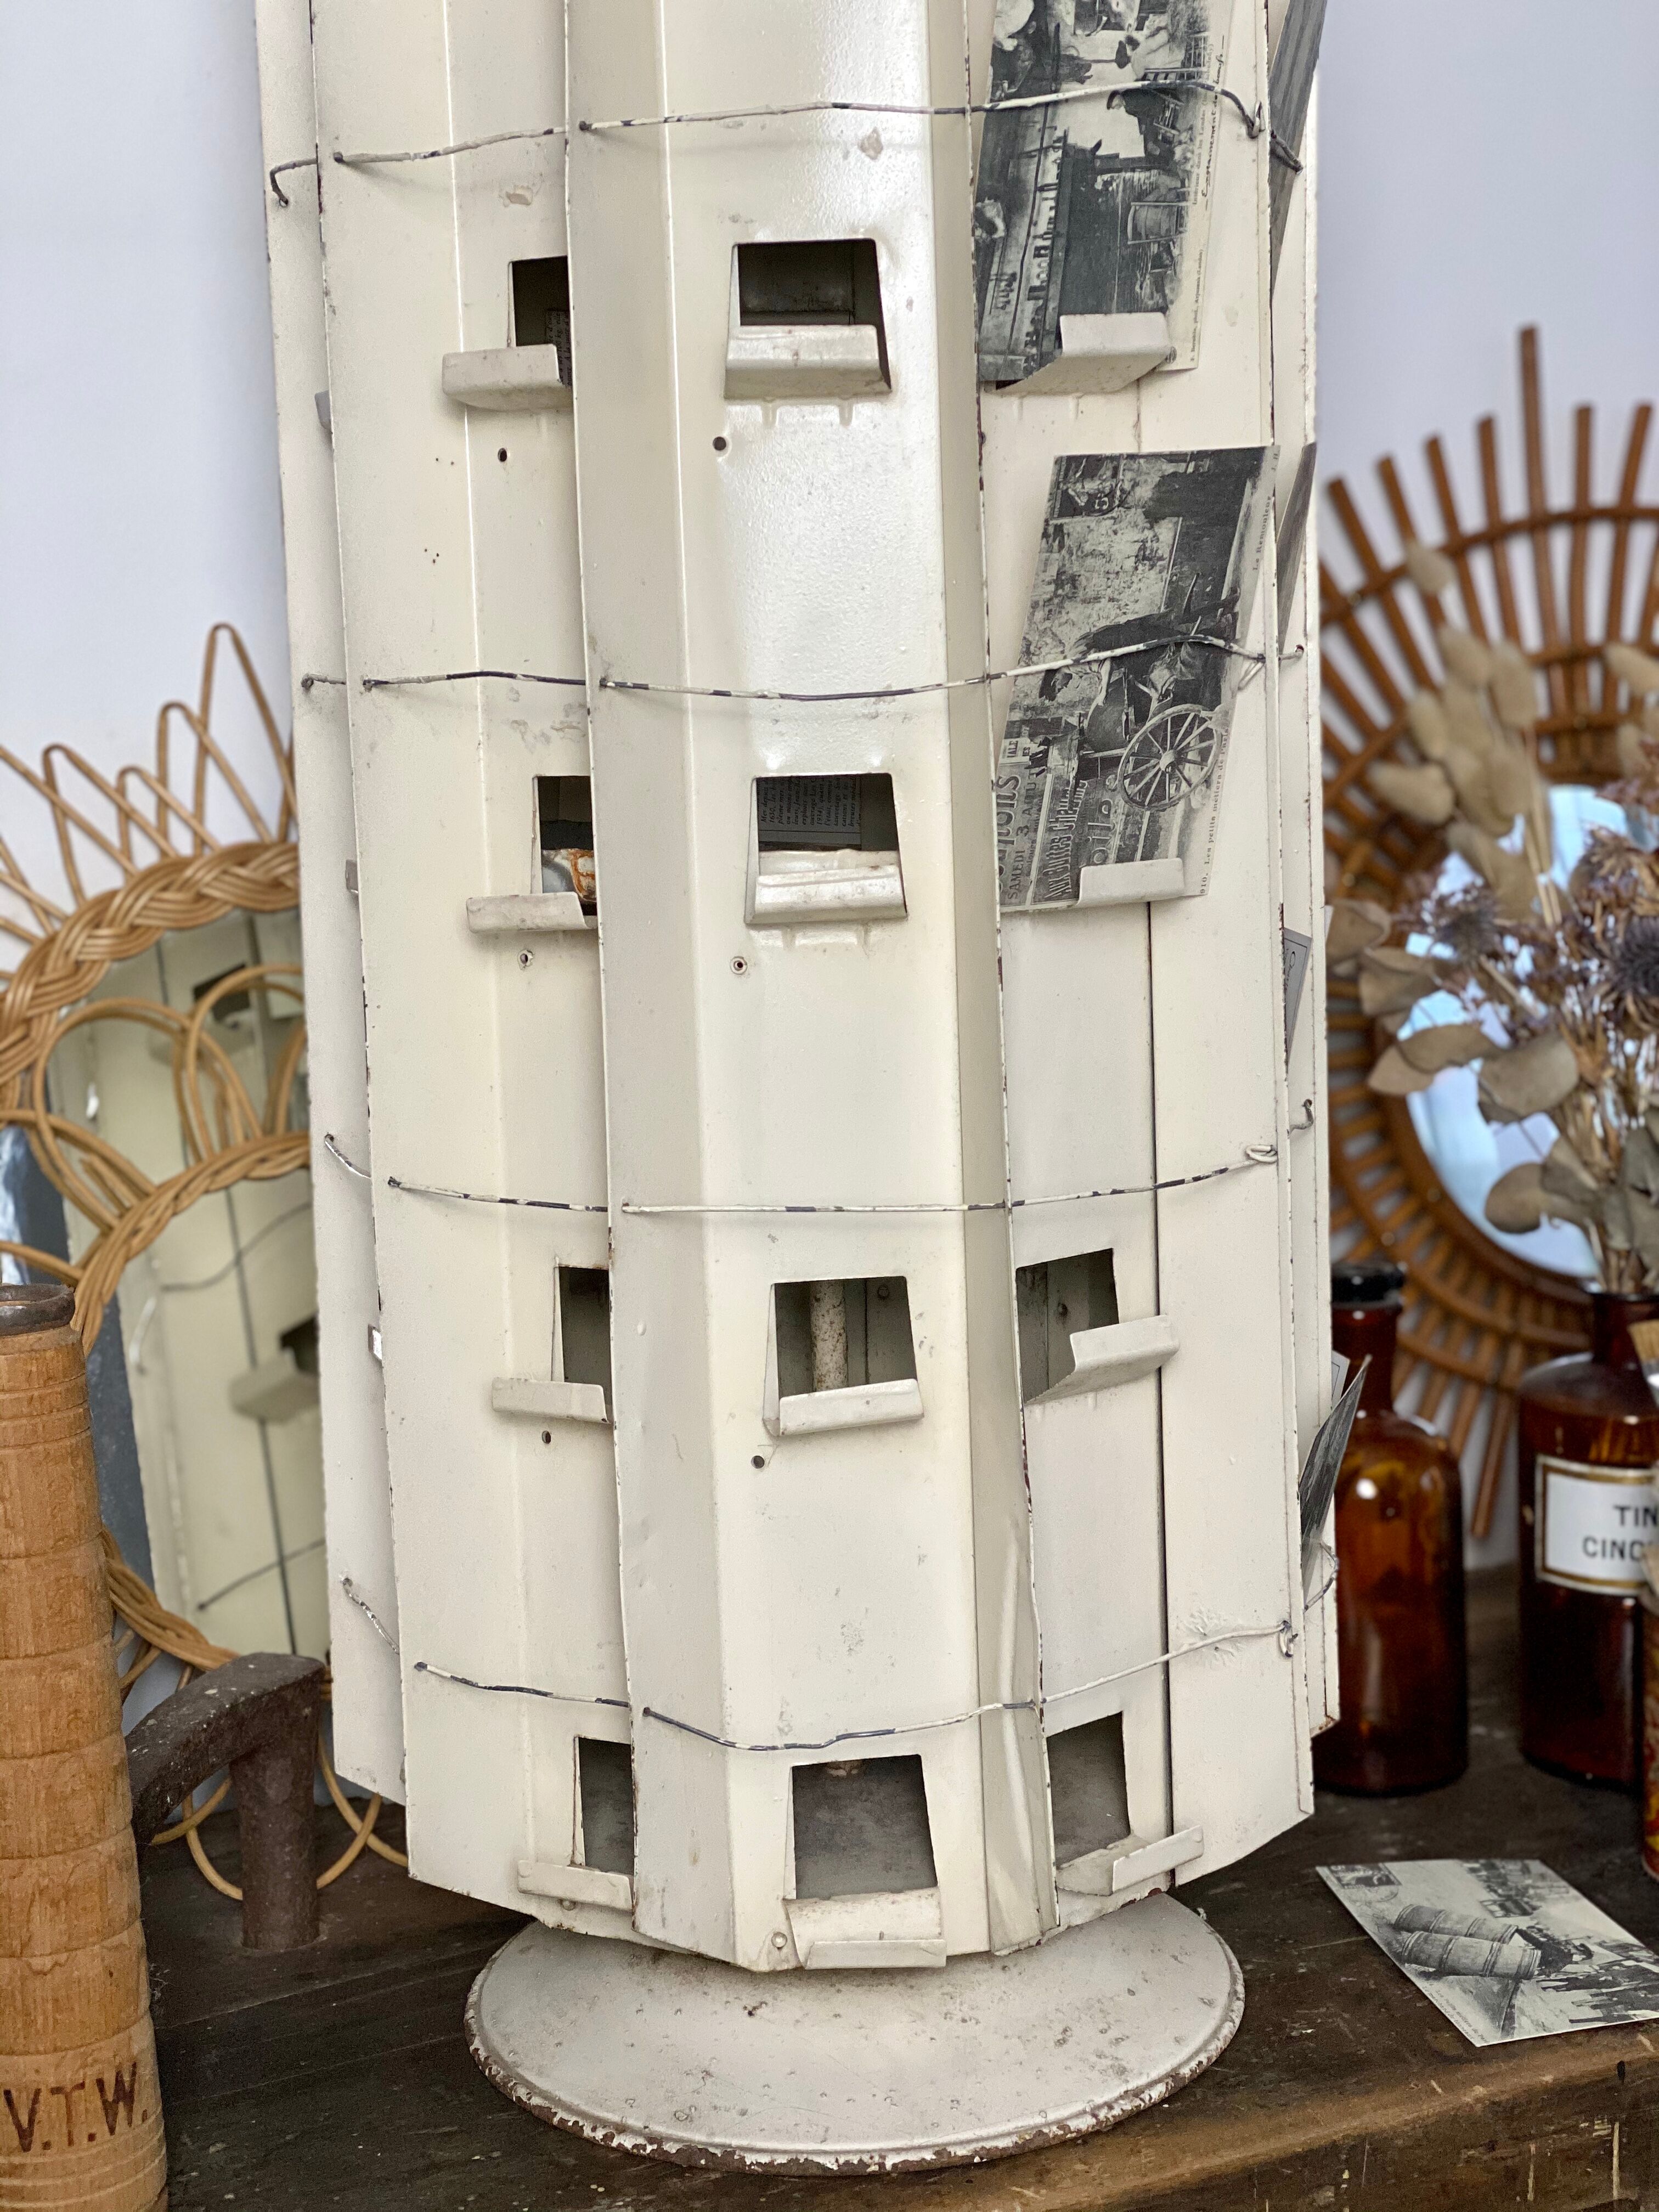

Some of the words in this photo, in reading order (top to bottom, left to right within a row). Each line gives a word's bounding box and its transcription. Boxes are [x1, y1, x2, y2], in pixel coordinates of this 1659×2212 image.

[1200, 873, 1208, 894] 910.
[1218, 759, 1224, 771] de
[1007, 849, 1025, 899] SAMEDI
